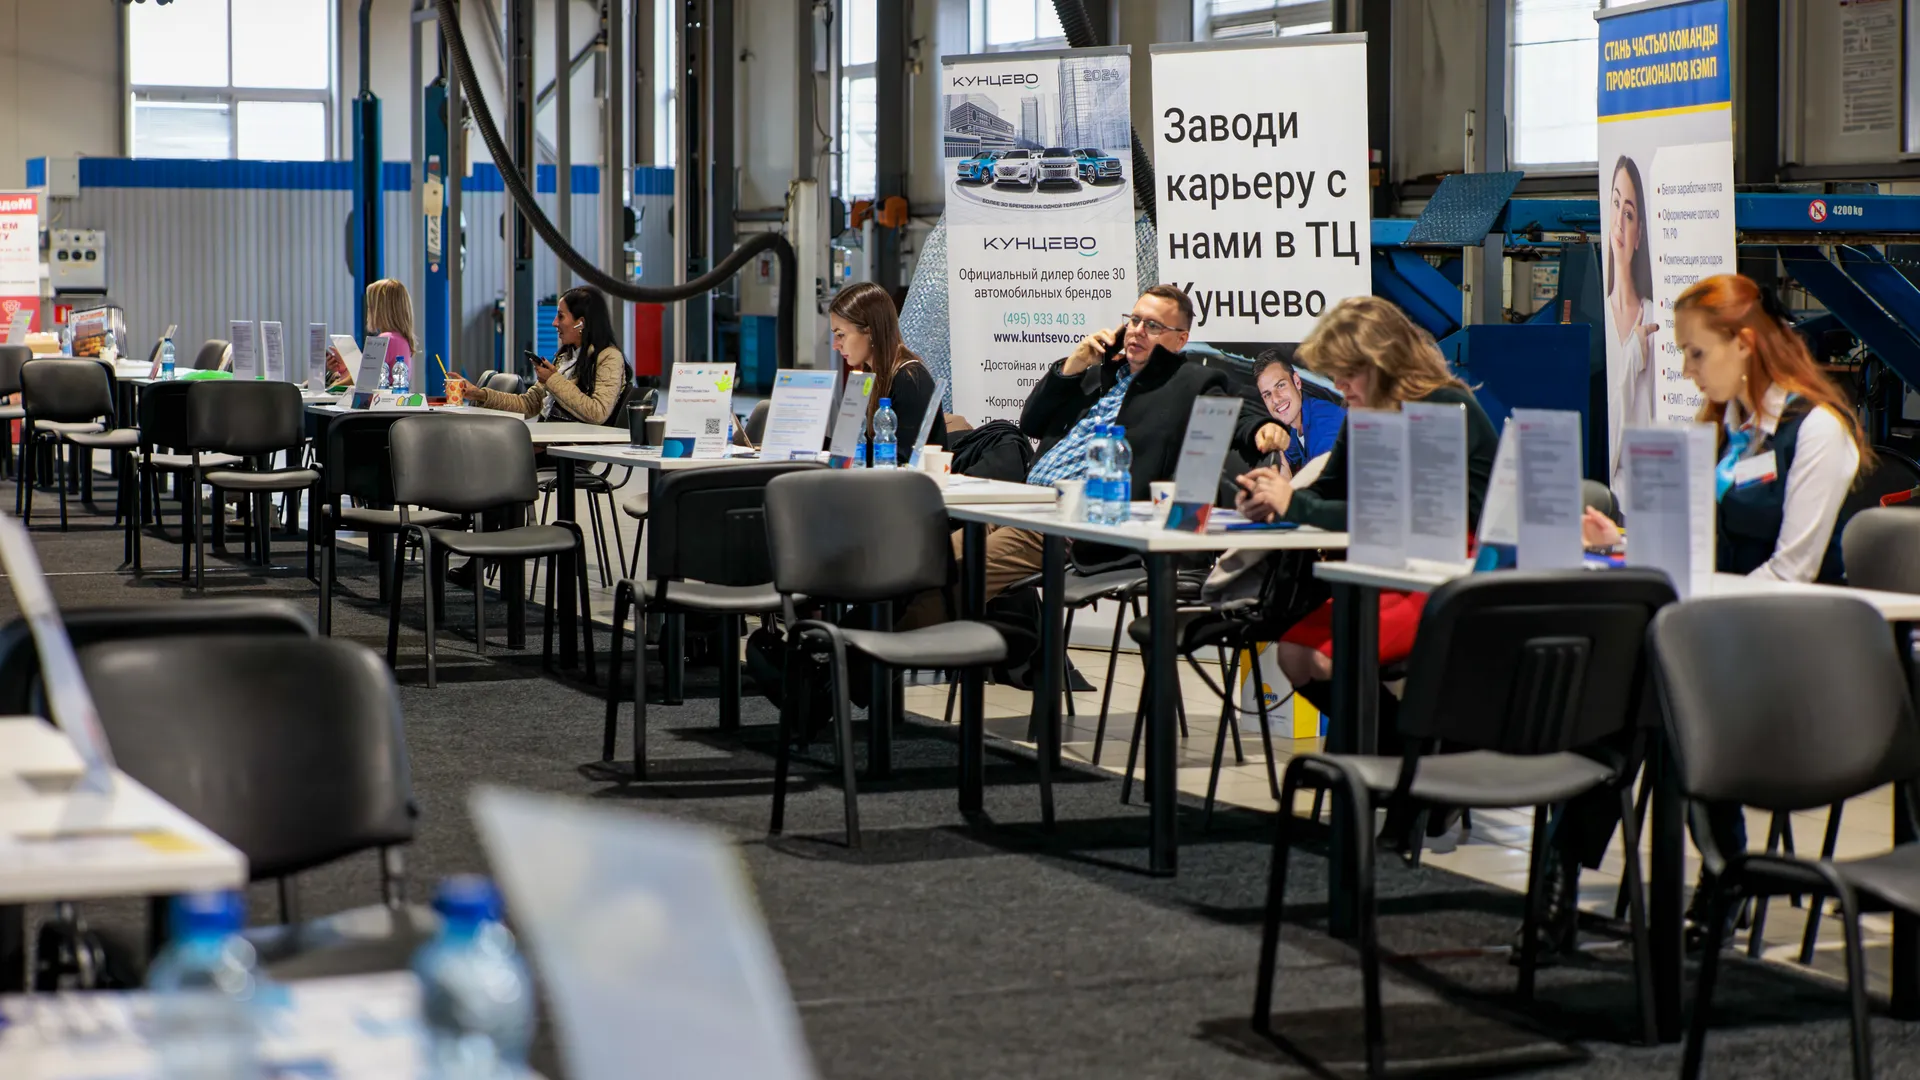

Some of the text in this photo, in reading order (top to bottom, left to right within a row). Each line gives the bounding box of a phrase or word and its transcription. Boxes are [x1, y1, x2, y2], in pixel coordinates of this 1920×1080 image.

[1605, 24, 1718, 61] СТАНЬ ЧАСТЬЮ КОМАНДЫ
[953, 73, 1038, 87] КУНЦЕВО
[1083, 69, 1120, 82] 2024
[1606, 57, 1717, 91] ПРОФЕССИОНАЛОВ КЭМП
[1164, 107, 1298, 147] Заводи
[1167, 169, 1347, 210] карьеру с
[982, 198, 1000, 207] БОЛЕЕ
[1833, 205, 1863, 216] 4200 kg
[984, 237, 1097, 252] КУНЦЕВО
[1169, 221, 1360, 266] нами в ТЦ
[959, 268, 1126, 282] Официальный дилер более 30
[974, 286, 1112, 301] автомобильных брендов
[1003, 312, 1086, 327] (495) 933 40 33
[984, 359, 1037, 372] Достойная
[1039, 362, 1046, 371] и
[988, 395, 1026, 409] Корпор
